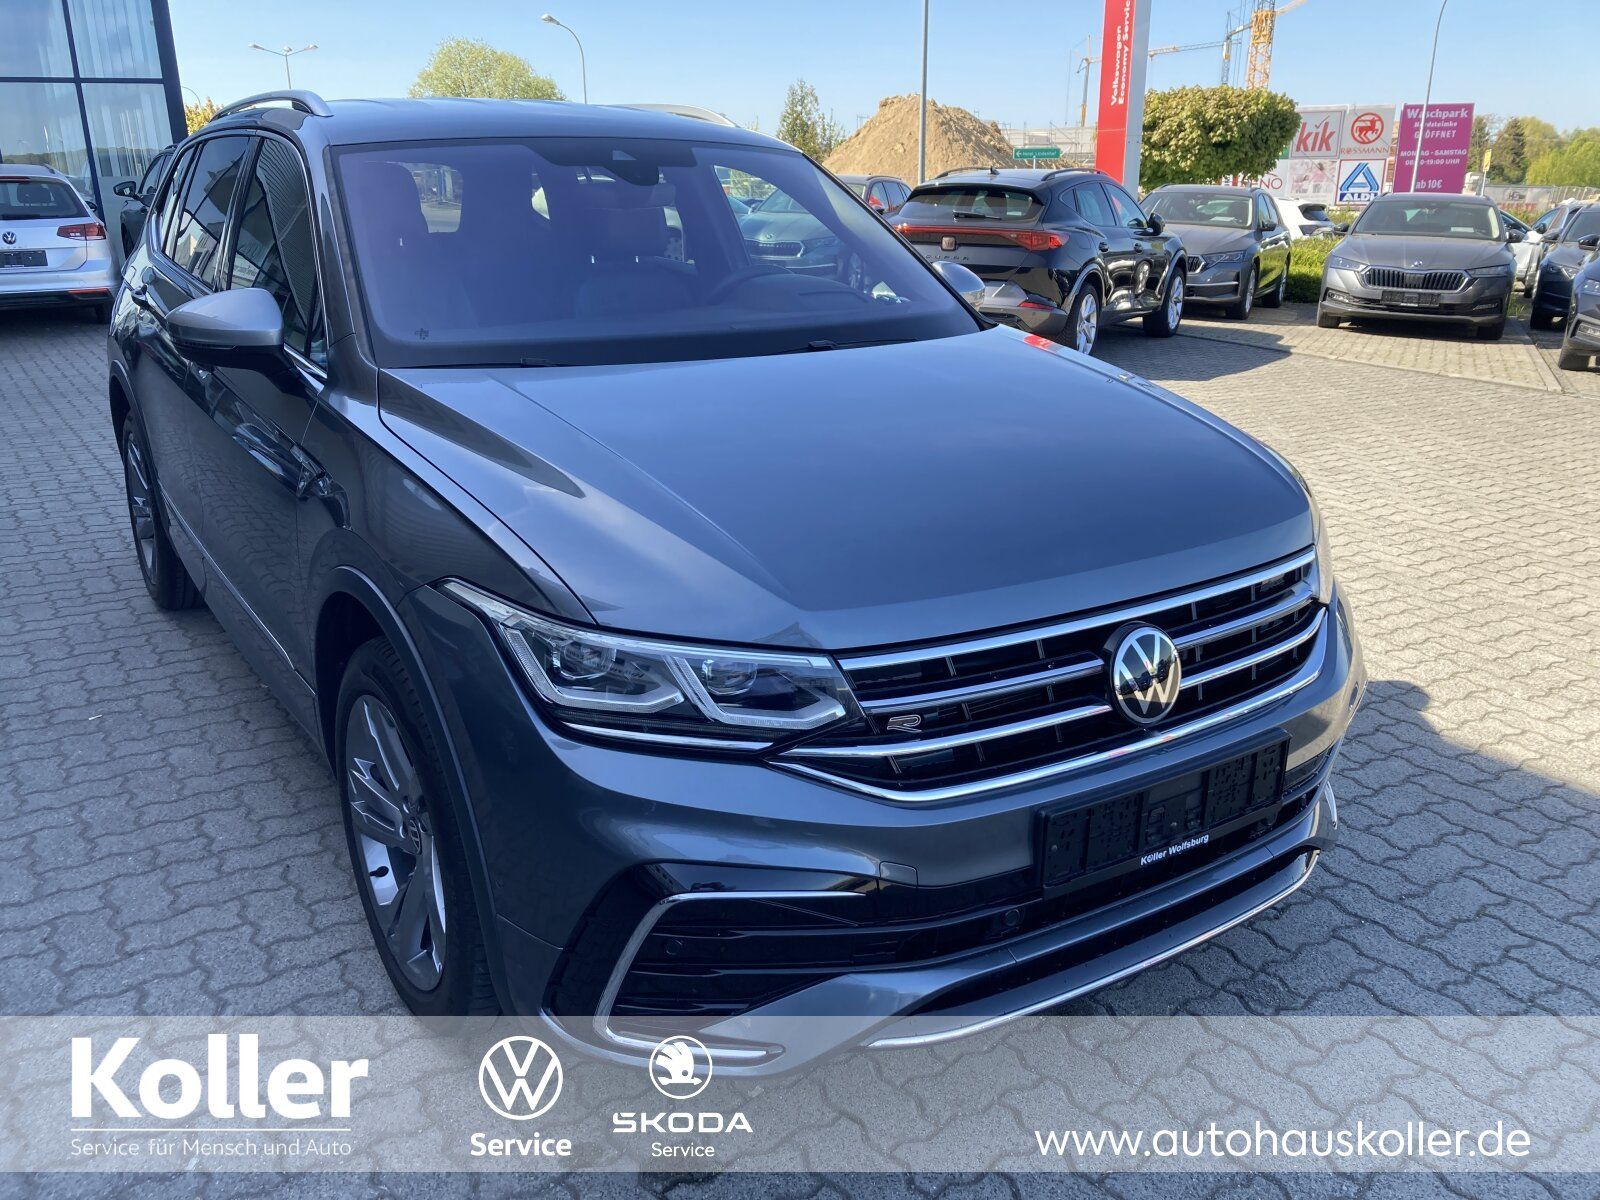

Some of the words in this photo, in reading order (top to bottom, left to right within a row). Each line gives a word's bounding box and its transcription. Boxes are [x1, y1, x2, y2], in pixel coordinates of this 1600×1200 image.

[1111, 25, 1122, 107] Volkswagen
[1118, 45, 1129, 105] Economy
[1414, 130, 1457, 139] GÖFFNET
[1340, 146, 1389, 155] ROSSMANN
[1415, 180, 1427, 189] ab
[1427, 179, 1443, 189] 10€
[1343, 192, 1377, 202] ALDI
[1140, 850, 1168, 866] Koller
[1168, 834, 1209, 855] Wolfsburg
